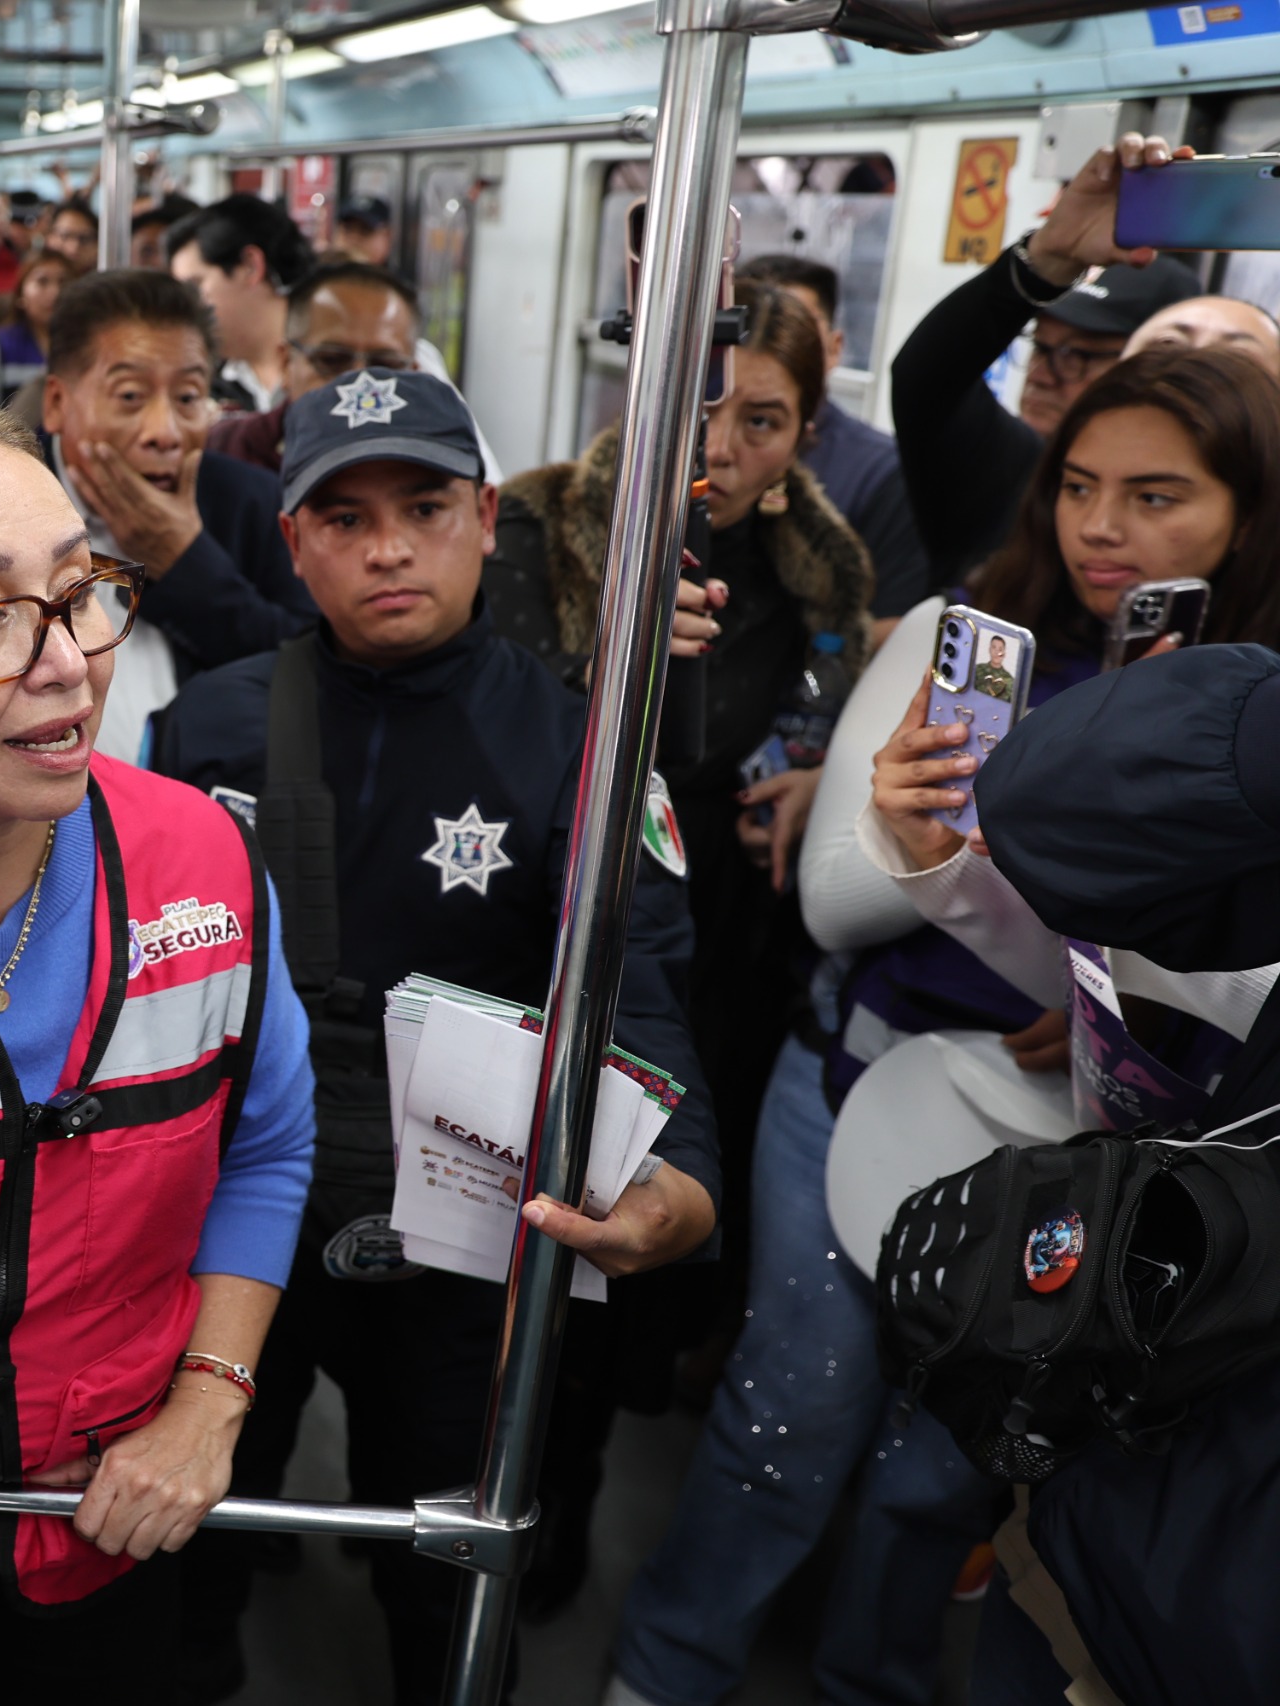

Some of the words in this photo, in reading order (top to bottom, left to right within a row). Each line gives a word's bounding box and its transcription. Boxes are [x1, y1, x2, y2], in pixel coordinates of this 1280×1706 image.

[137, 905, 226, 942] ECATEPEC
[163, 899, 197, 916] PLAN
[143, 914, 241, 962] SEGURA
